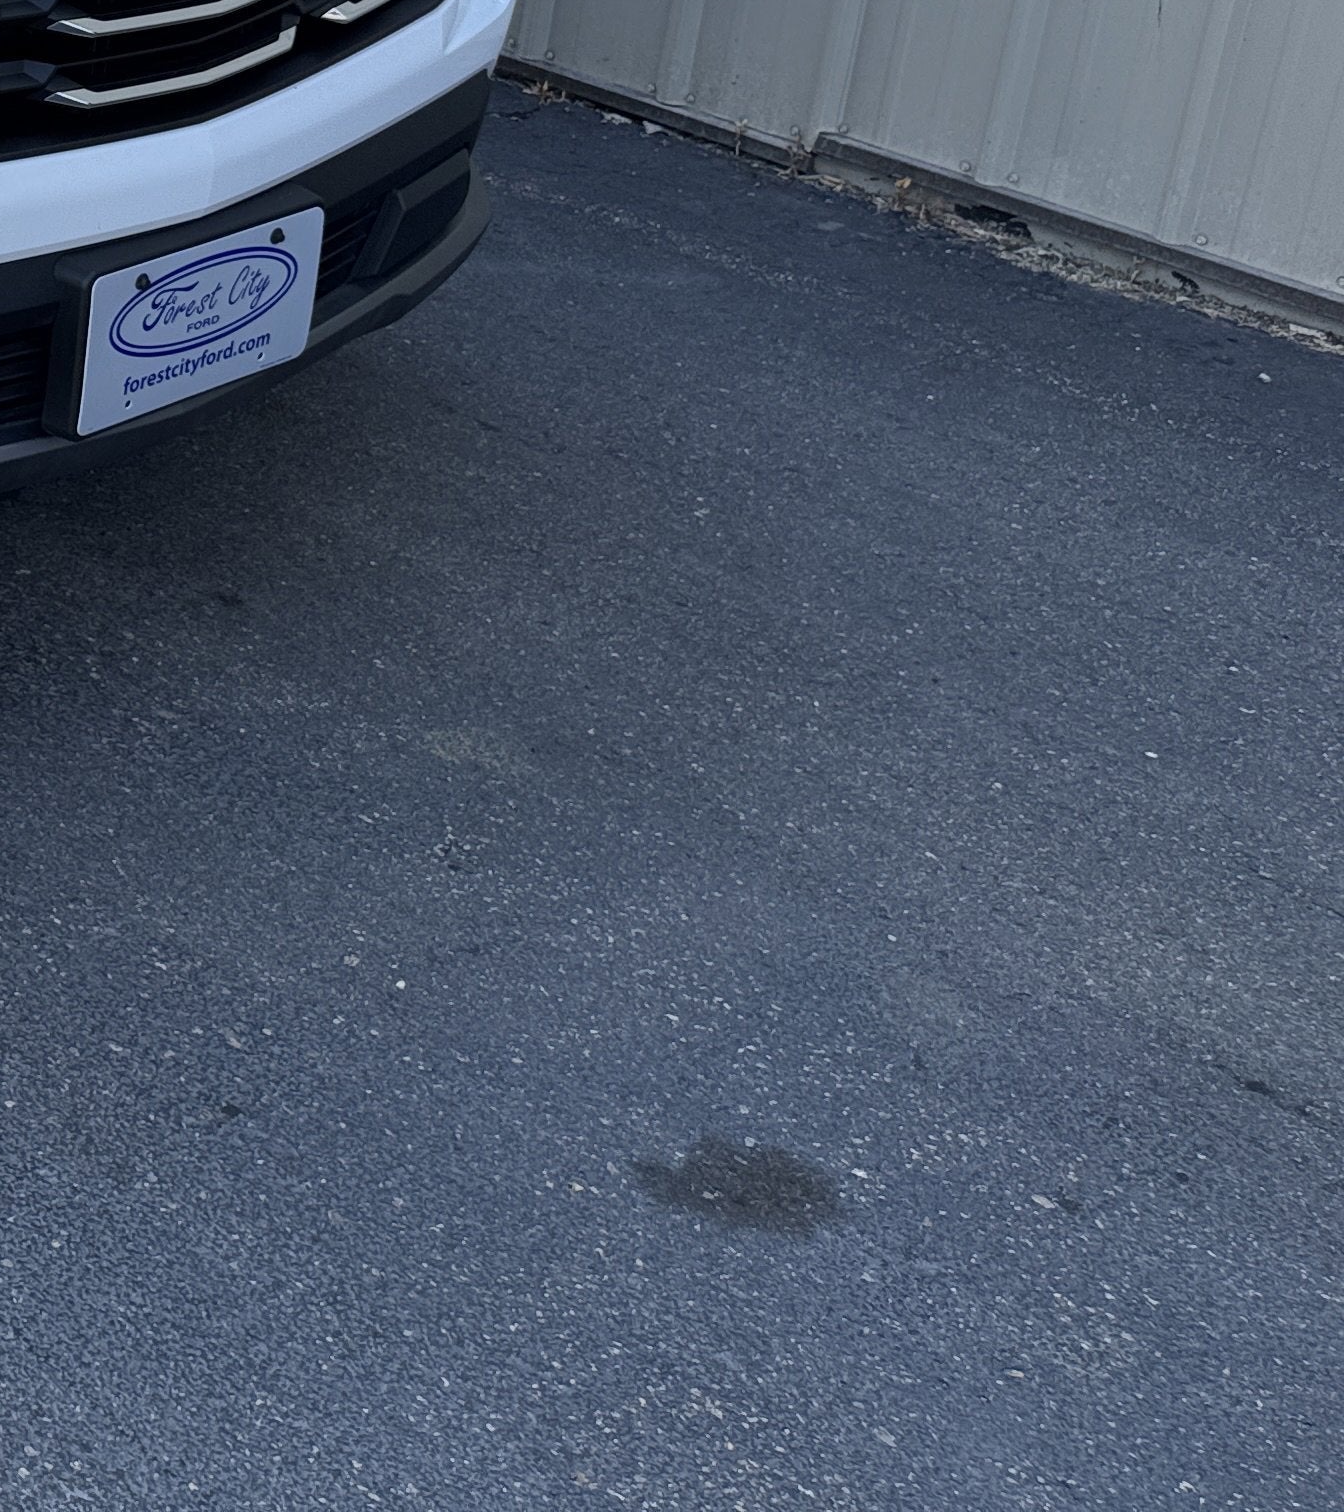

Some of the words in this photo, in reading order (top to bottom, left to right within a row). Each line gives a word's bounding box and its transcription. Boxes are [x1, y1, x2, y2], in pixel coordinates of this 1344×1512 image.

[143, 280, 222, 332] Forest
[228, 264, 271, 310] City
[185, 314, 221, 333] FORD
[123, 332, 271, 396] forestcityford.com
